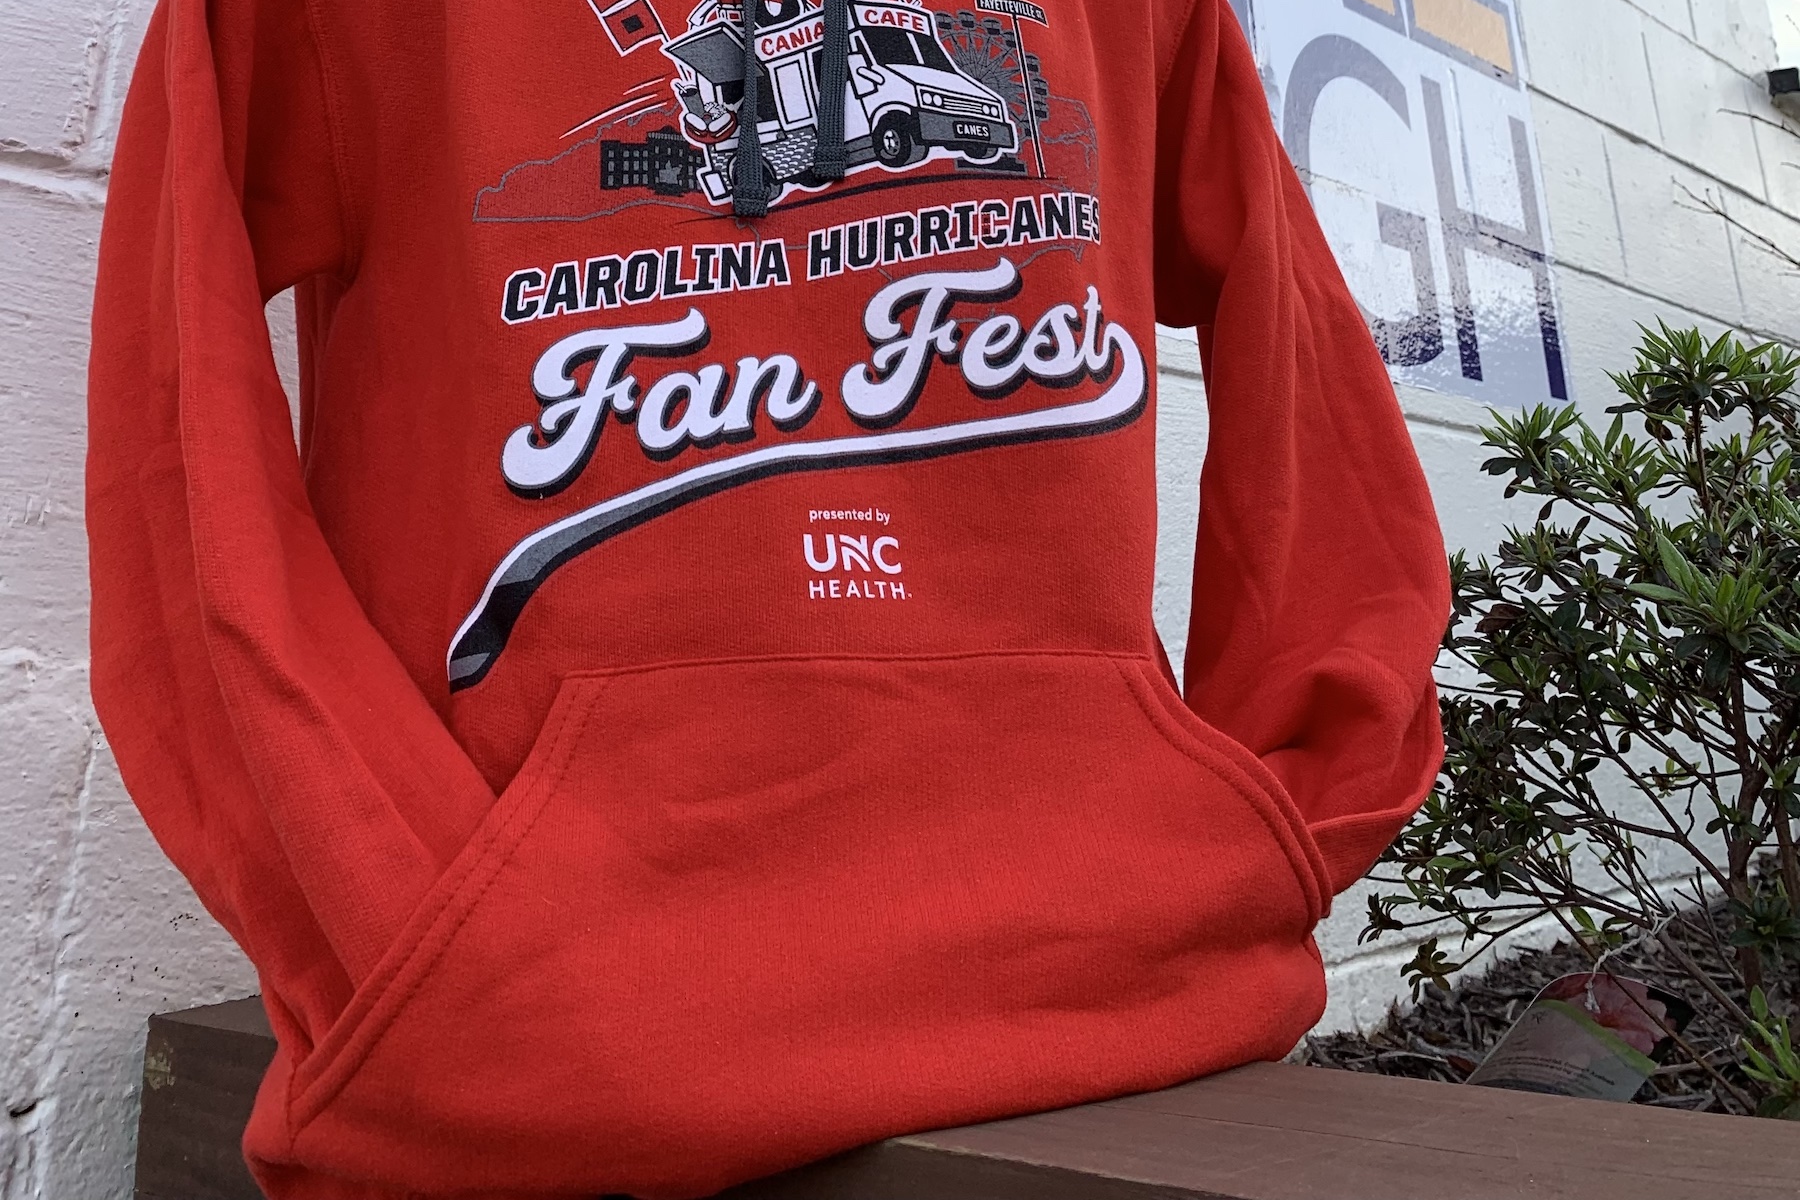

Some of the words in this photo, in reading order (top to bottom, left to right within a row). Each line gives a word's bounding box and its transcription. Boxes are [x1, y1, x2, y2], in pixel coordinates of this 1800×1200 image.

[761, 20, 826, 56] CANIA
[864, 9, 925, 32] CAFE
[956, 123, 990, 137] CANES
[501, 238, 790, 326] CAROLINA
[501, 307, 824, 498] Fan
[840, 257, 1148, 432] Fest
[809, 507, 873, 523] presented
[875, 507, 891, 526] by
[803, 533, 903, 575] UNC
